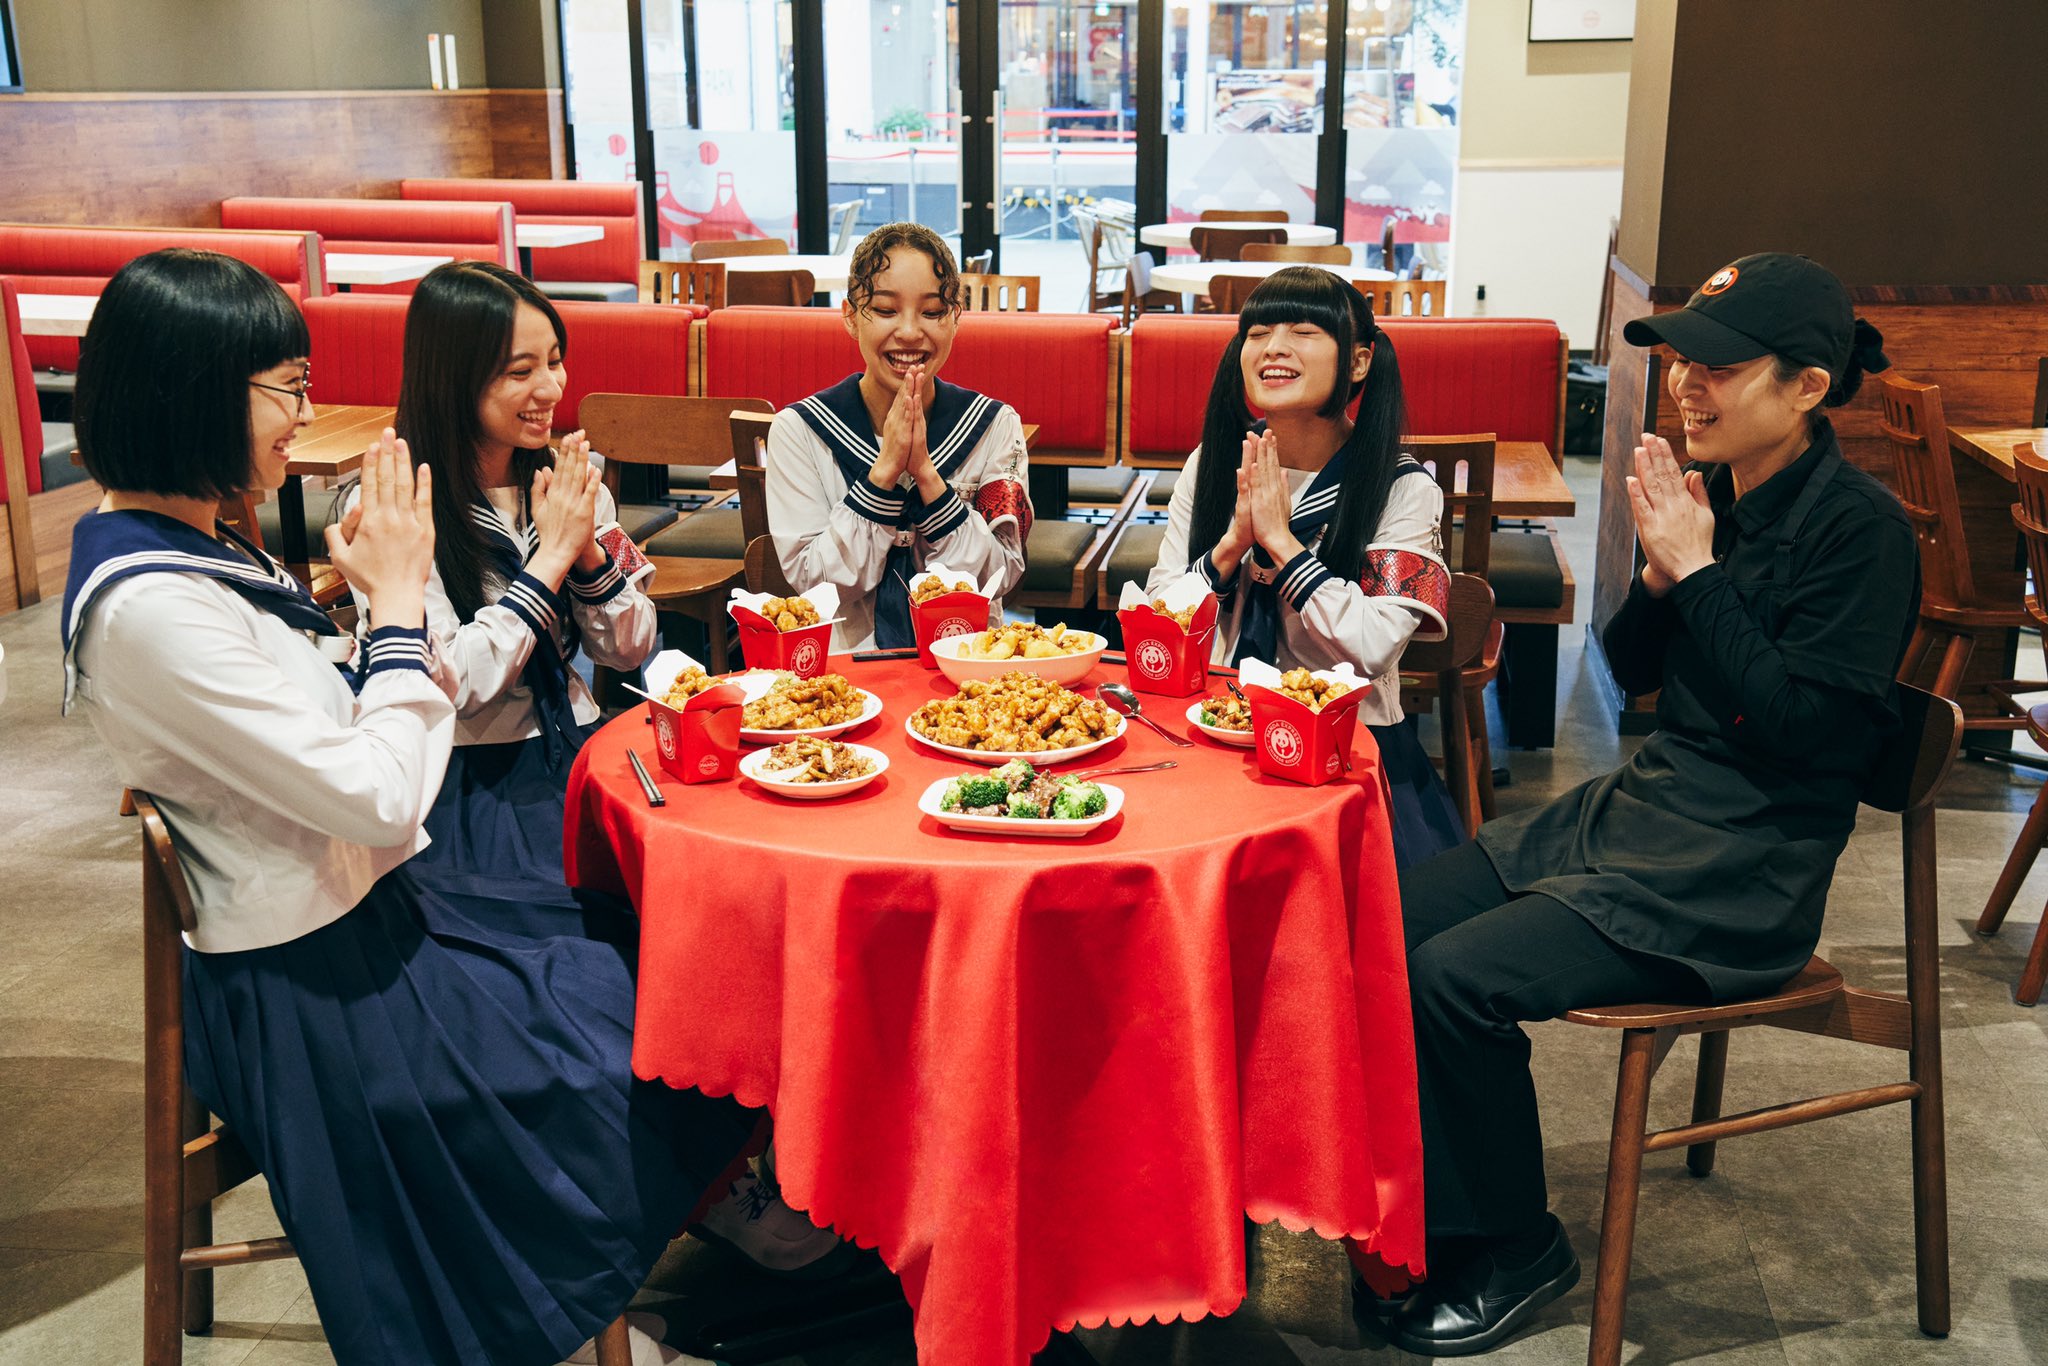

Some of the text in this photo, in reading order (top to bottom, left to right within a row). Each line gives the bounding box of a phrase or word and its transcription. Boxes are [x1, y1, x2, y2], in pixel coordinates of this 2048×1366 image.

[936, 620, 951, 636] PANDA
[792, 641, 805, 660] PANDA
[1137, 641, 1170, 660] PANDA EXPRESS
[1266, 721, 1301, 745] PANDA EXPRESS
